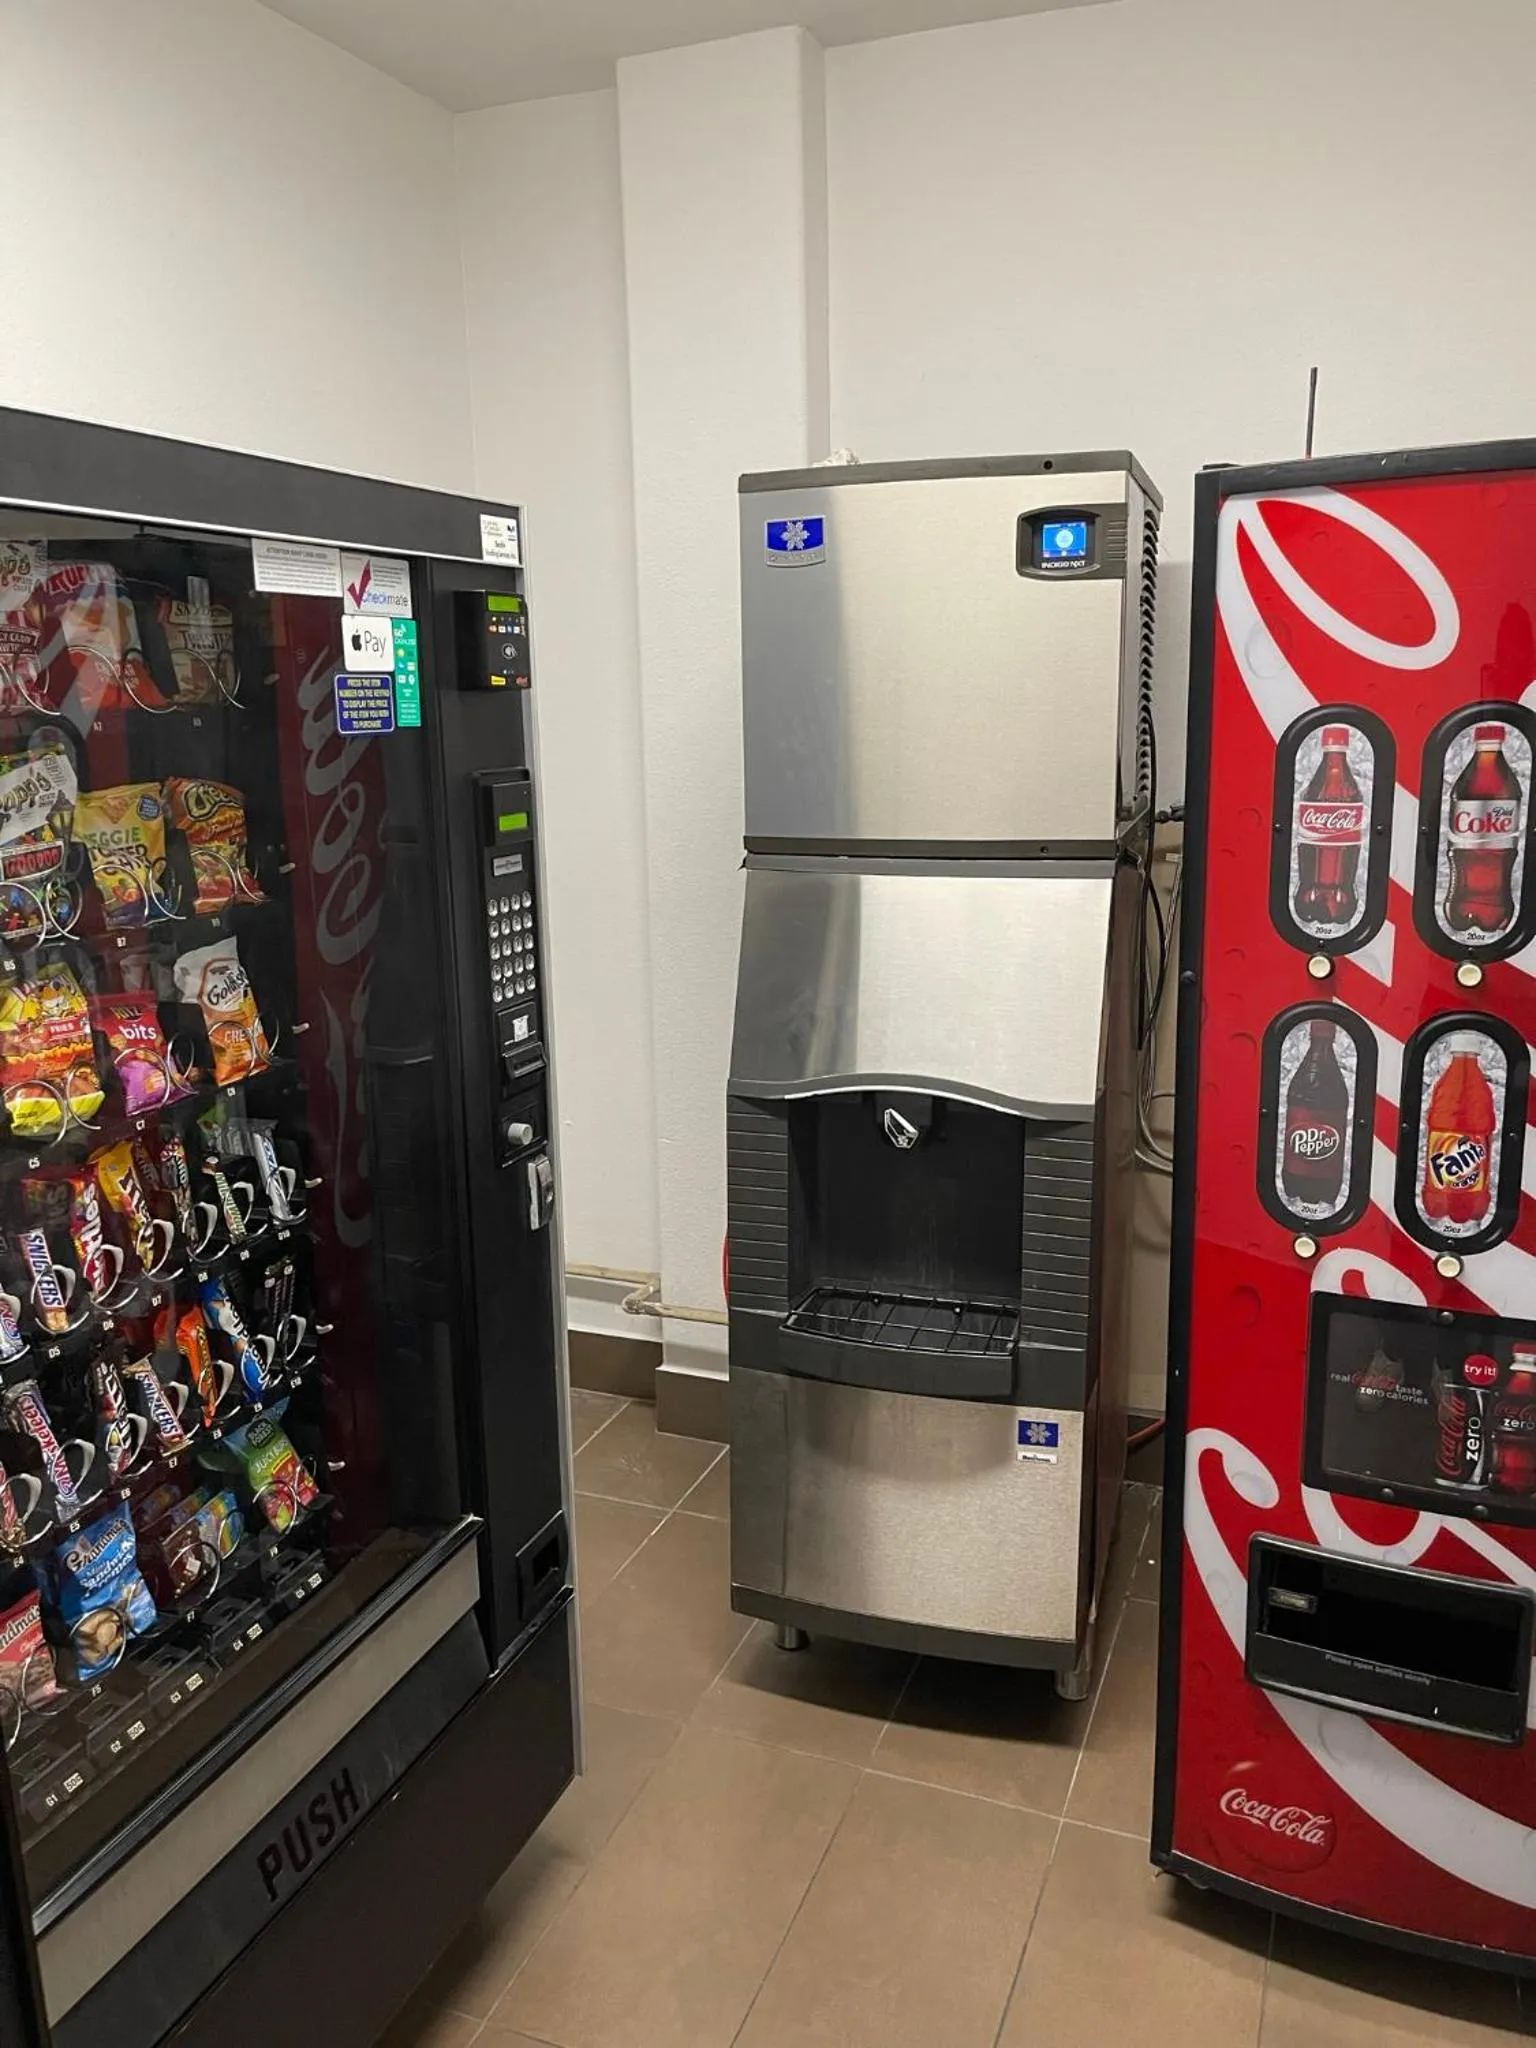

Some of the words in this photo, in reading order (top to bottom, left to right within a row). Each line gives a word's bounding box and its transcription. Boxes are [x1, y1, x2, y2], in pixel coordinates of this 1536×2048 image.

[1041, 561, 1070, 569] INDIGO
[364, 629, 387, 658] Pay
[1302, 807, 1359, 830] Coca-Cola
[1455, 810, 1513, 834] Coke
[3, 959, 16, 972] B5
[119, 1025, 157, 1041] bits
[1293, 1128, 1337, 1155] Pepper
[1307, 1127, 1325, 1143] Dr
[28, 1157, 41, 1169] C5
[1430, 1141, 1487, 1185] Fanta
[1451, 1173, 1480, 1188] orange
[103, 1318, 114, 1331] D6
[48, 1345, 61, 1359] D5
[1463, 1363, 1482, 1377] try
[1330, 1372, 1351, 1383] real
[1396, 1383, 1423, 1396] taste
[1360, 1386, 1384, 1398] zero
[1386, 1390, 1429, 1405] calories
[1503, 1417, 1535, 1430] zero
[1466, 1416, 1481, 1461] zero
[70, 1521, 81, 1533] E5
[13, 1555, 25, 1567] E4
[45, 1793, 59, 1807] G1
[63, 1773, 84, 1793] 50¢
[1219, 1787, 1332, 1846] Coca-Cola
[256, 1767, 361, 1903] PUSH
